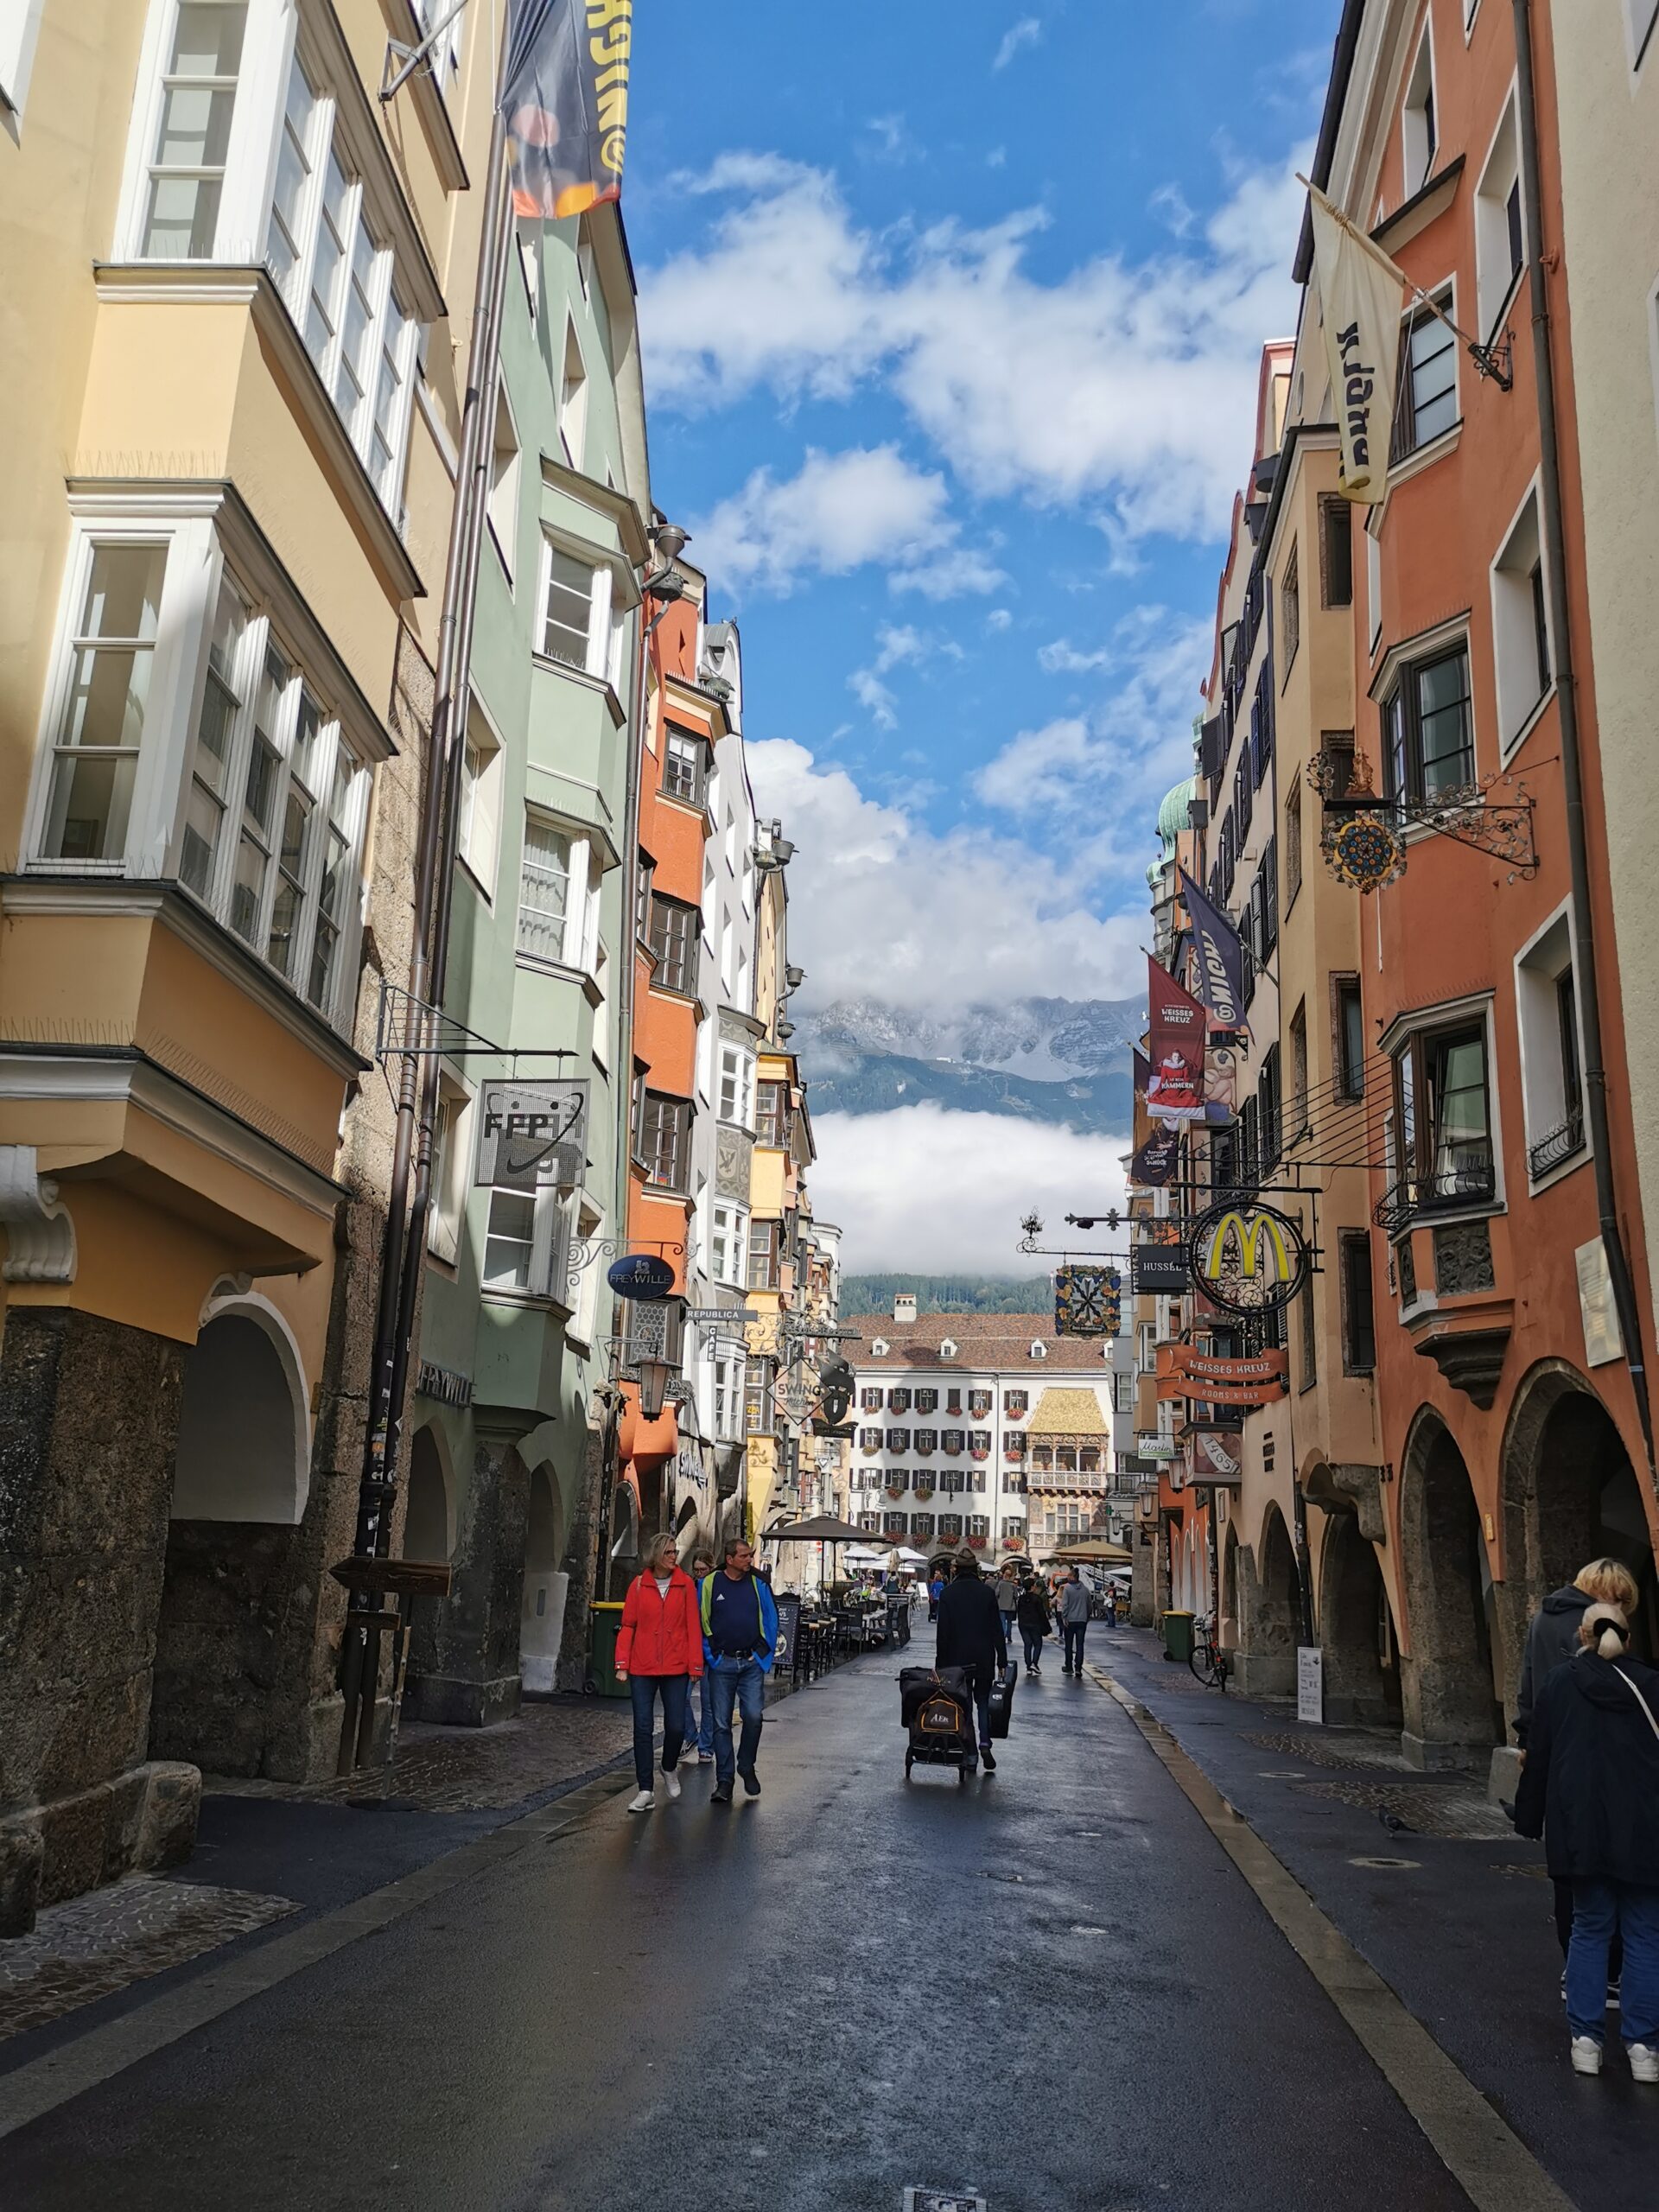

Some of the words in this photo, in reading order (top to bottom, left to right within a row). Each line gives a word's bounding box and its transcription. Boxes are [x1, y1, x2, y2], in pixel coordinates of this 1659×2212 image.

[1161, 1008, 1194, 1017] WEISSES
[1164, 1015, 1191, 1024] KREUZ
[609, 1274, 671, 1284] FREYWILLE
[687, 1310, 740, 1319] REPUBLICA
[708, 1327, 716, 1360] CAFE
[1189, 1360, 1233, 1374] WEISSES
[1236, 1362, 1271, 1374] KREUZ
[778, 1383, 822, 1396] SWING
[1201, 1389, 1230, 1399] ROOMS
[1139, 1441, 1173, 1452] Martin
[1205, 1437, 1232, 1470] 1465
